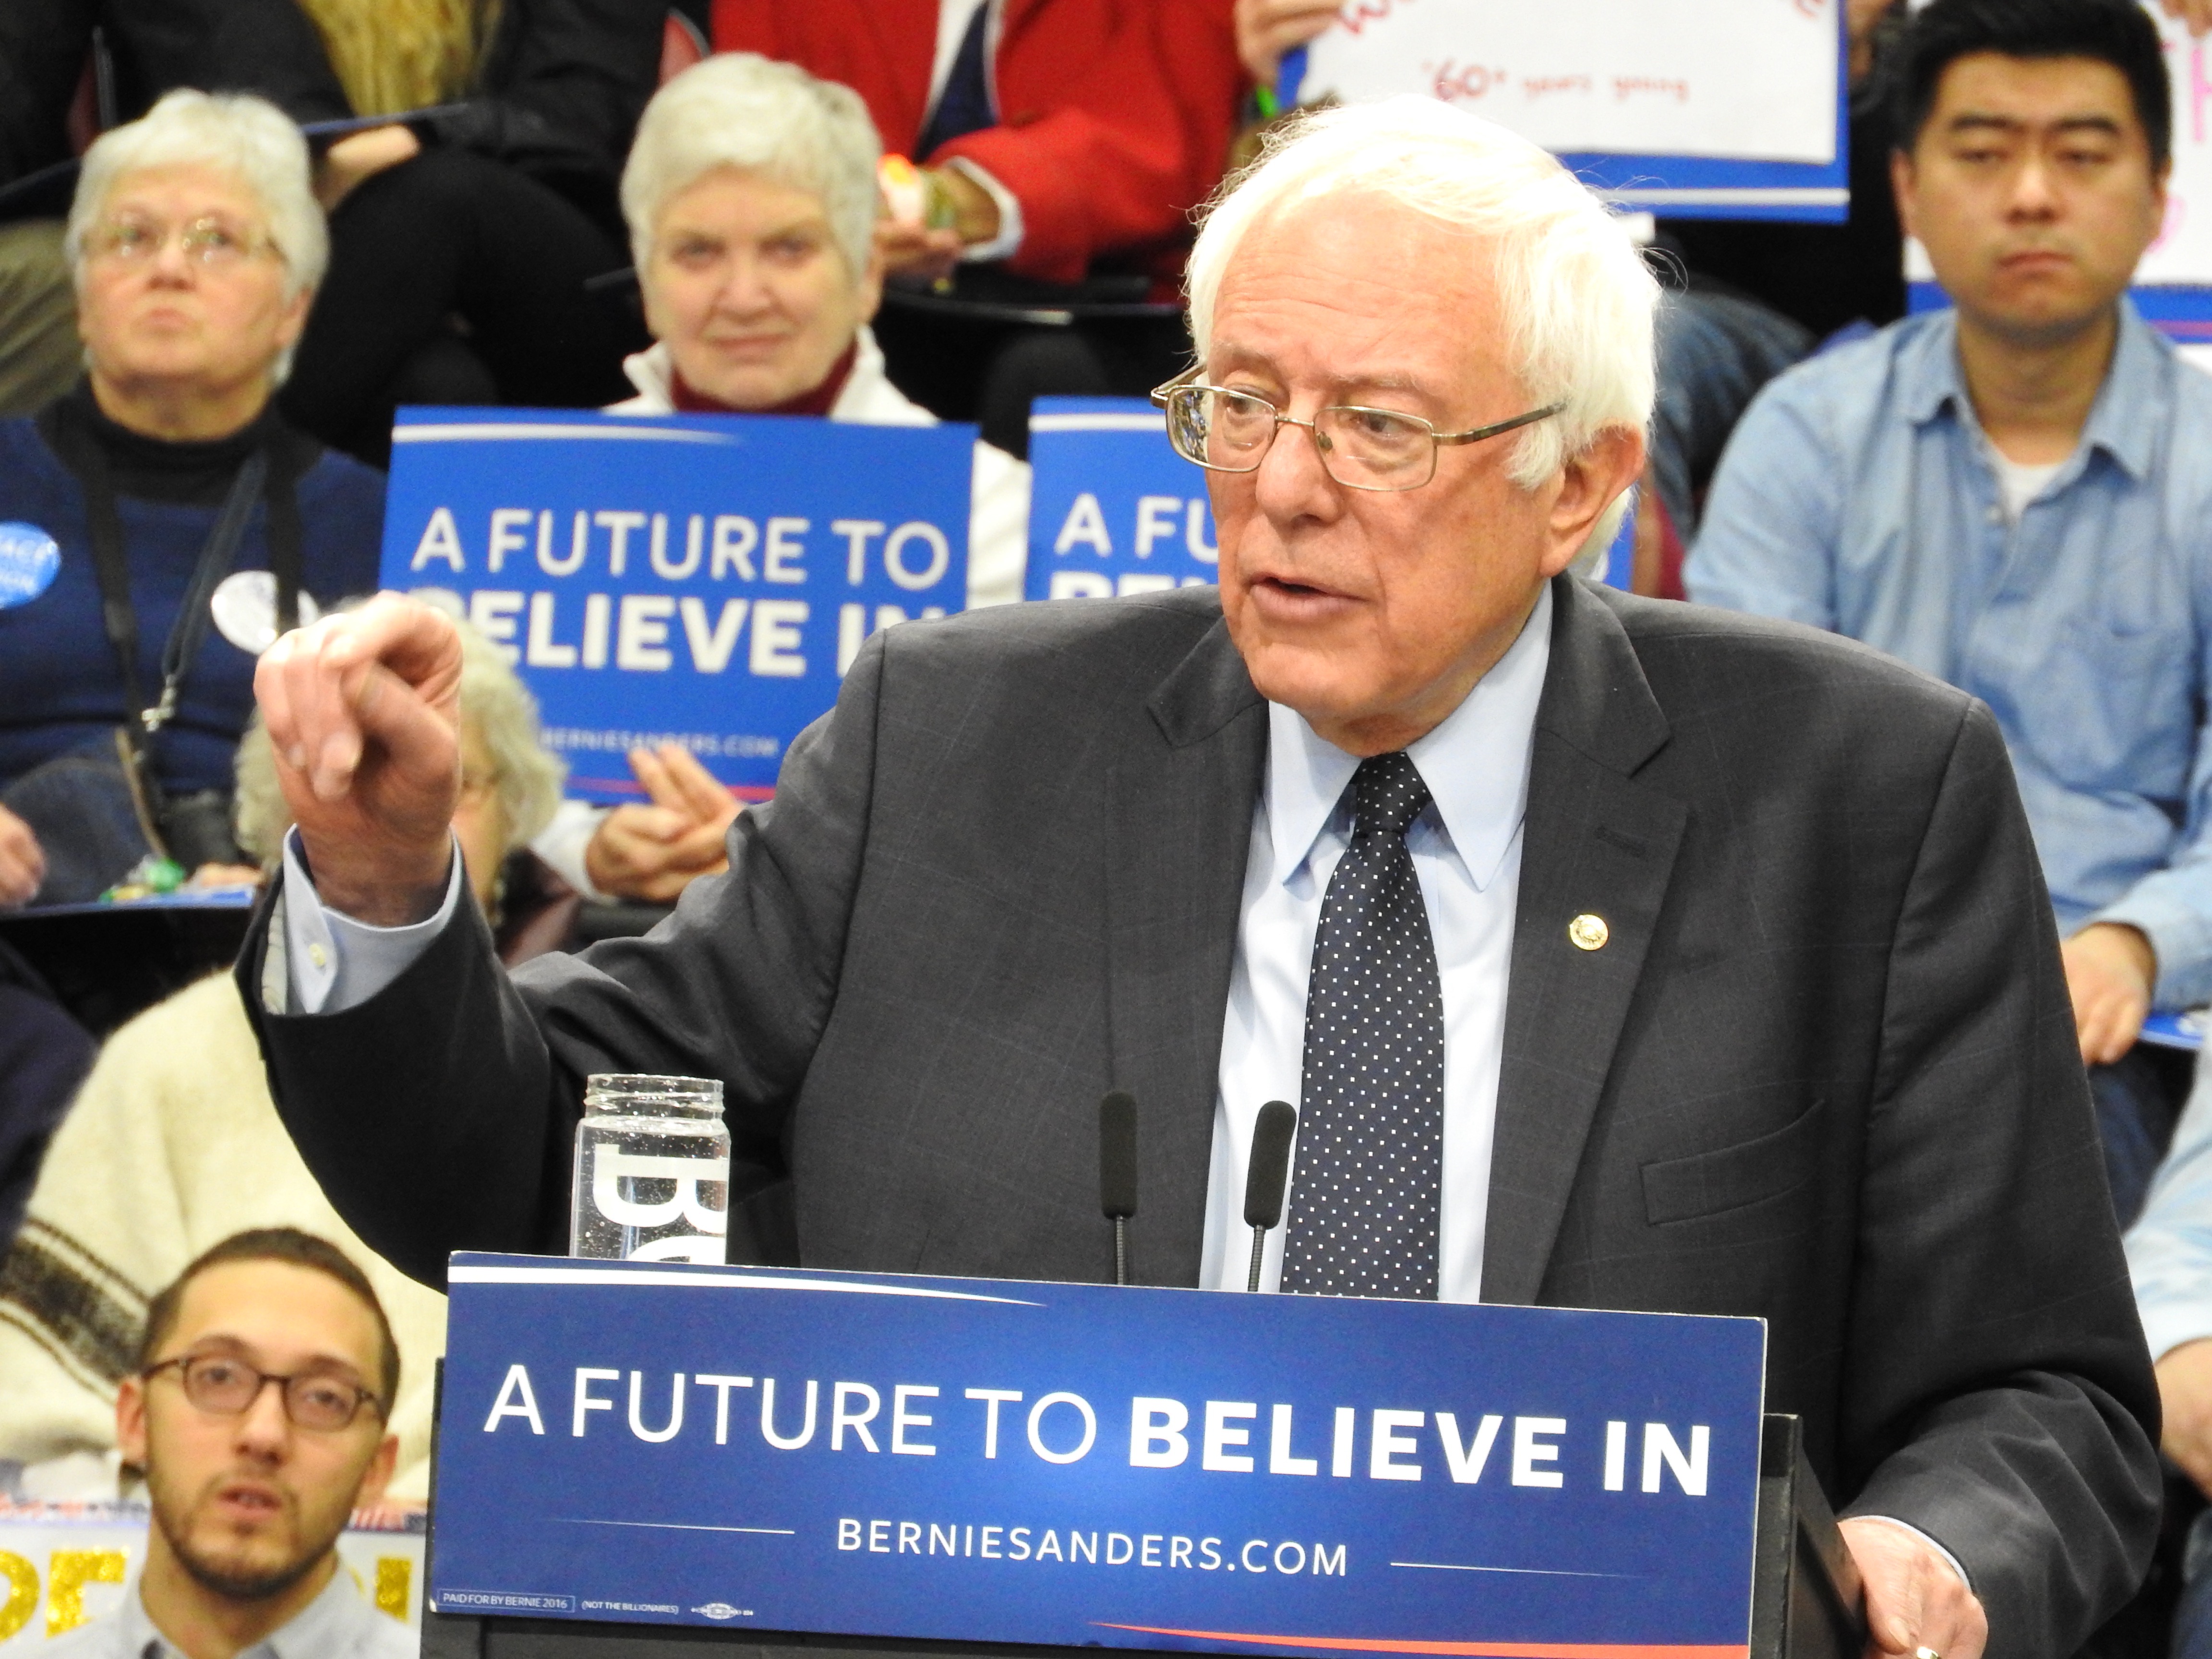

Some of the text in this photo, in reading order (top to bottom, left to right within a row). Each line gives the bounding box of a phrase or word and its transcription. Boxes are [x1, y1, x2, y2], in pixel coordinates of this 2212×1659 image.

[410, 507, 950, 590] A FUTURE TO
[1054, 493, 1113, 558] A
[837, 602, 948, 678] I
[483, 1364, 1710, 1496] A FUTURE TO BELIEVE IN
[837, 1518, 1346, 1577] BERNIESANDERS.COM
[443, 1593, 567, 1609] PAID FOR BY BERNIE 2016
[581, 1601, 679, 1615] (NOT THE BILLIONAIRES)
